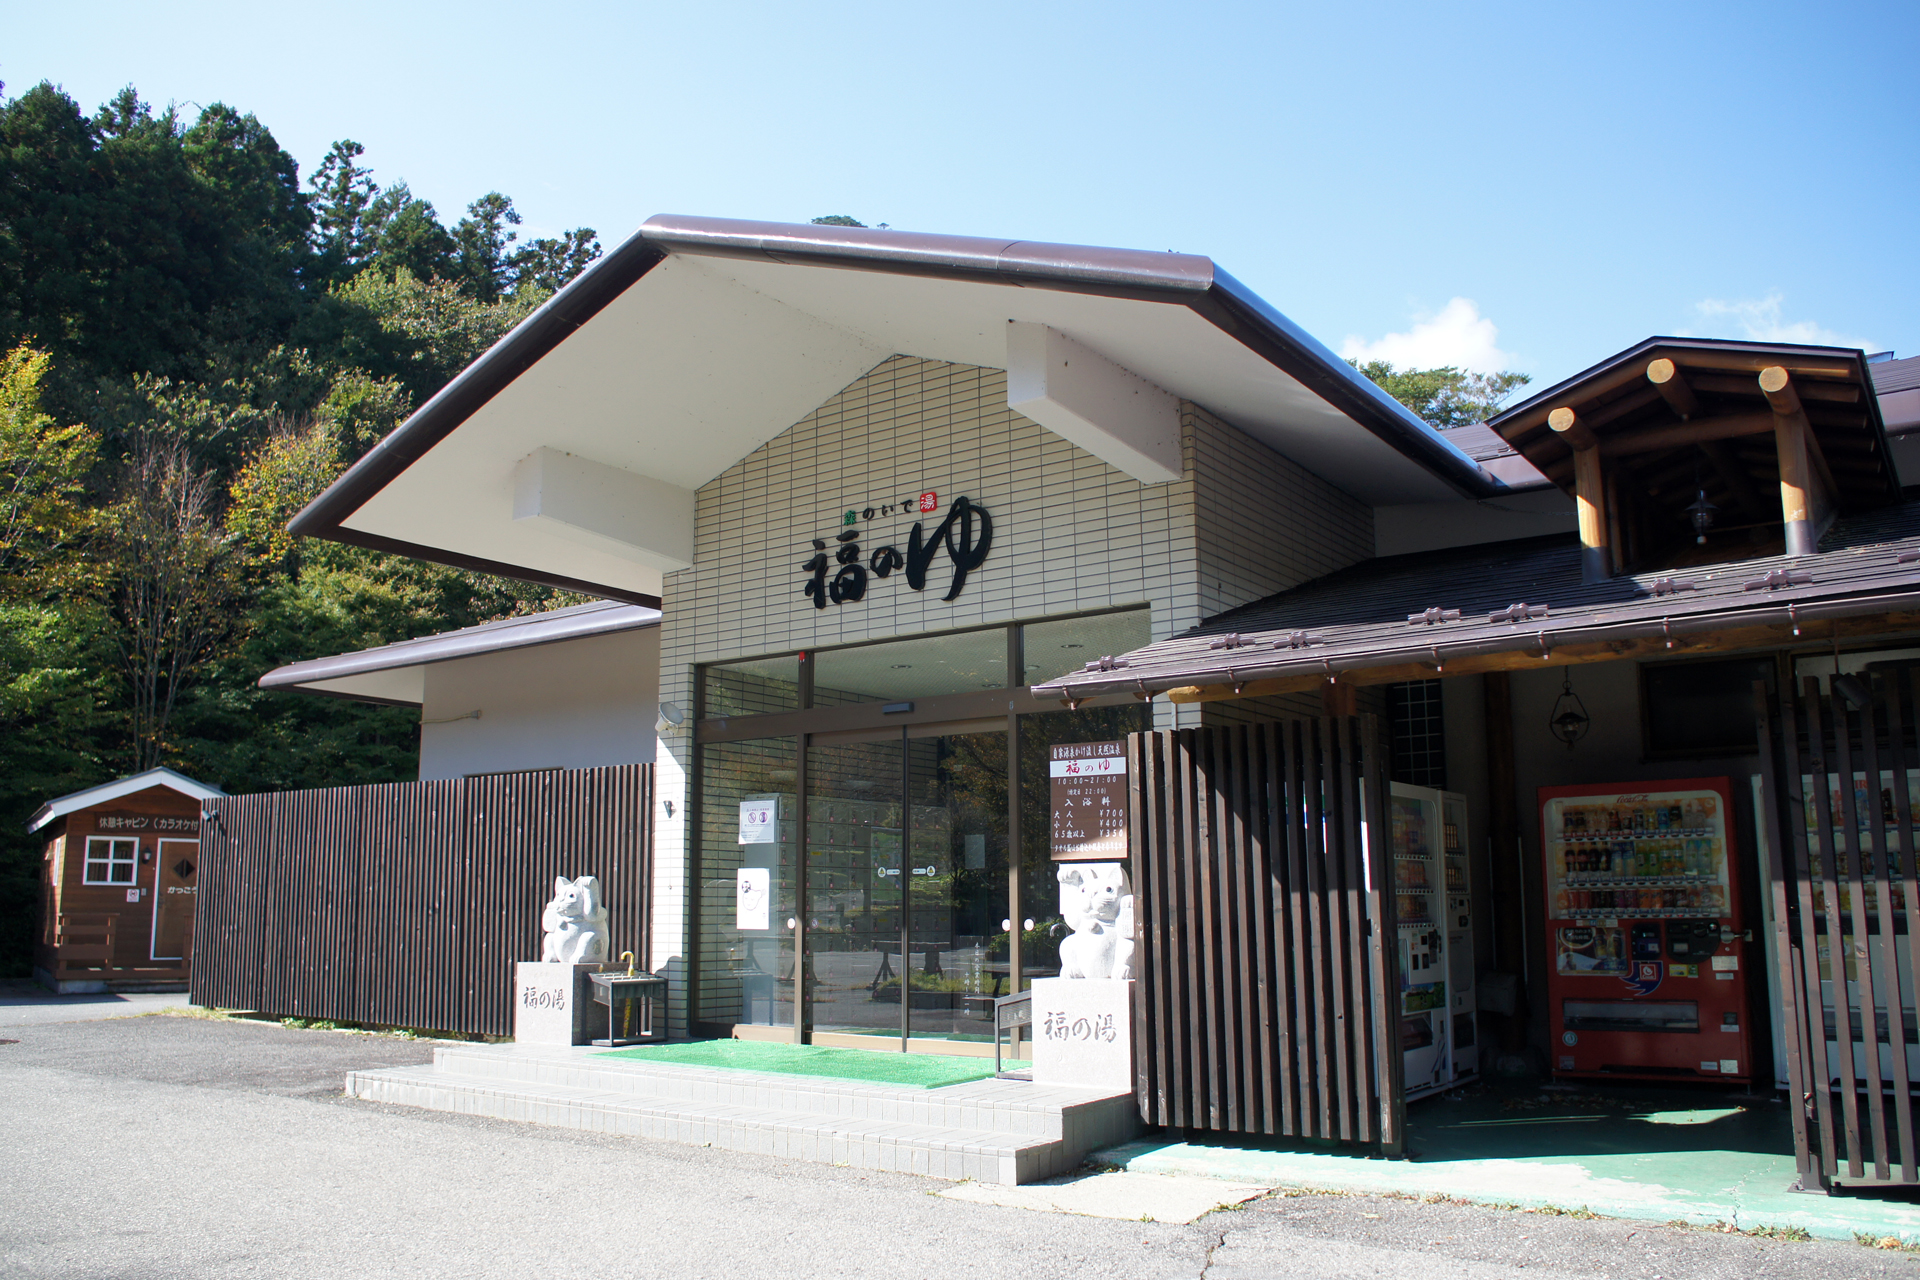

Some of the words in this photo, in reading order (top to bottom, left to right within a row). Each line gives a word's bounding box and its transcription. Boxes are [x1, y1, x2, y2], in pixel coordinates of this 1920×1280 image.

[802, 496, 993, 609] 福のゆ
[1066, 758, 1111, 775] 福のゆ
[523, 986, 565, 1011] 福の湯
[1044, 1011, 1117, 1043] 福の湯
